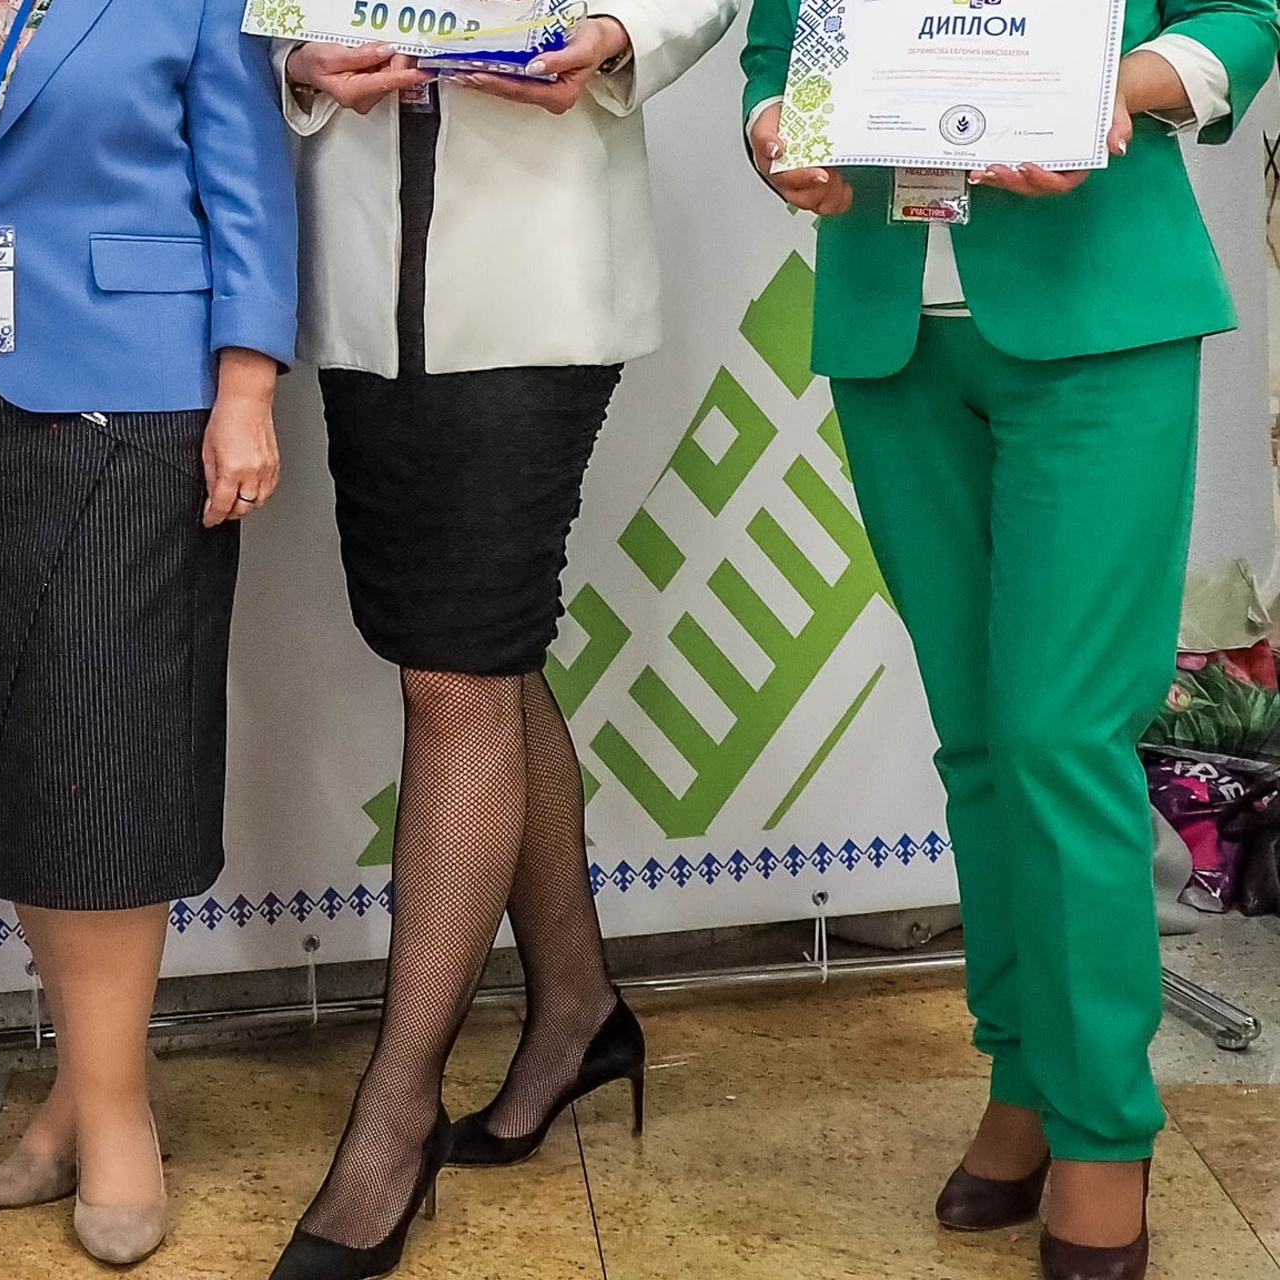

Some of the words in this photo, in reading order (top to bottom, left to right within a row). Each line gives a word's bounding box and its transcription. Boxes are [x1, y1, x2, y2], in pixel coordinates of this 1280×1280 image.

[350, 0, 388, 30] 50
[397, 6, 457, 36] 000
[918, 16, 1026, 39] ДИПЛОМ
